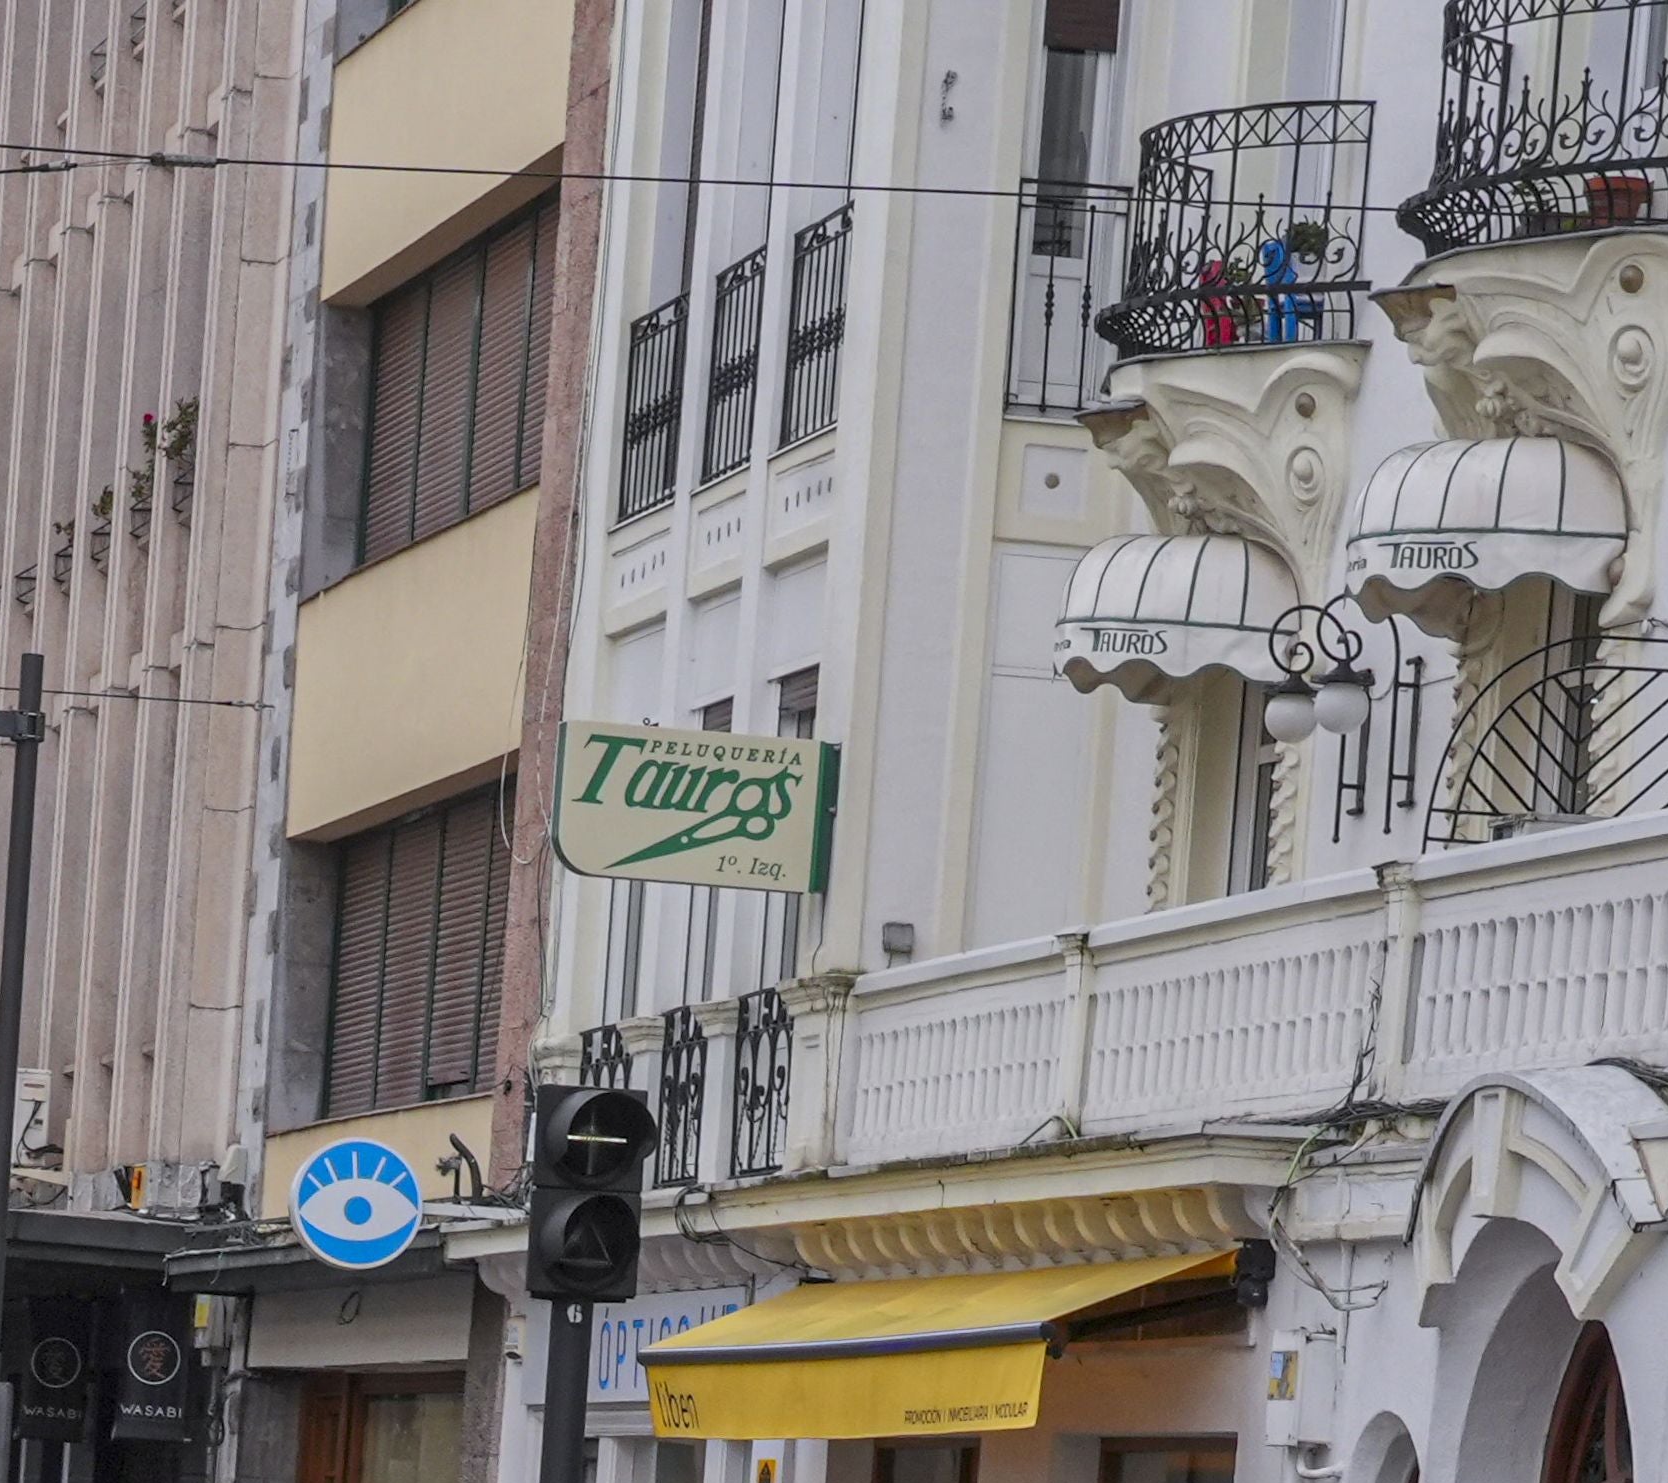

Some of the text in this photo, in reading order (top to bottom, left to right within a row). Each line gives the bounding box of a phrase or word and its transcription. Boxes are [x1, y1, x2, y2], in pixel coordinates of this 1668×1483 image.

[1377, 541, 1479, 569] TAUROS
[1080, 627, 1168, 655] TAUROS
[649, 739, 803, 766] PELUQUERÍA
[749, 857, 786, 878] Izq.
[23, 1403, 82, 1420] WASABI
[120, 1403, 182, 1419] WASABI
